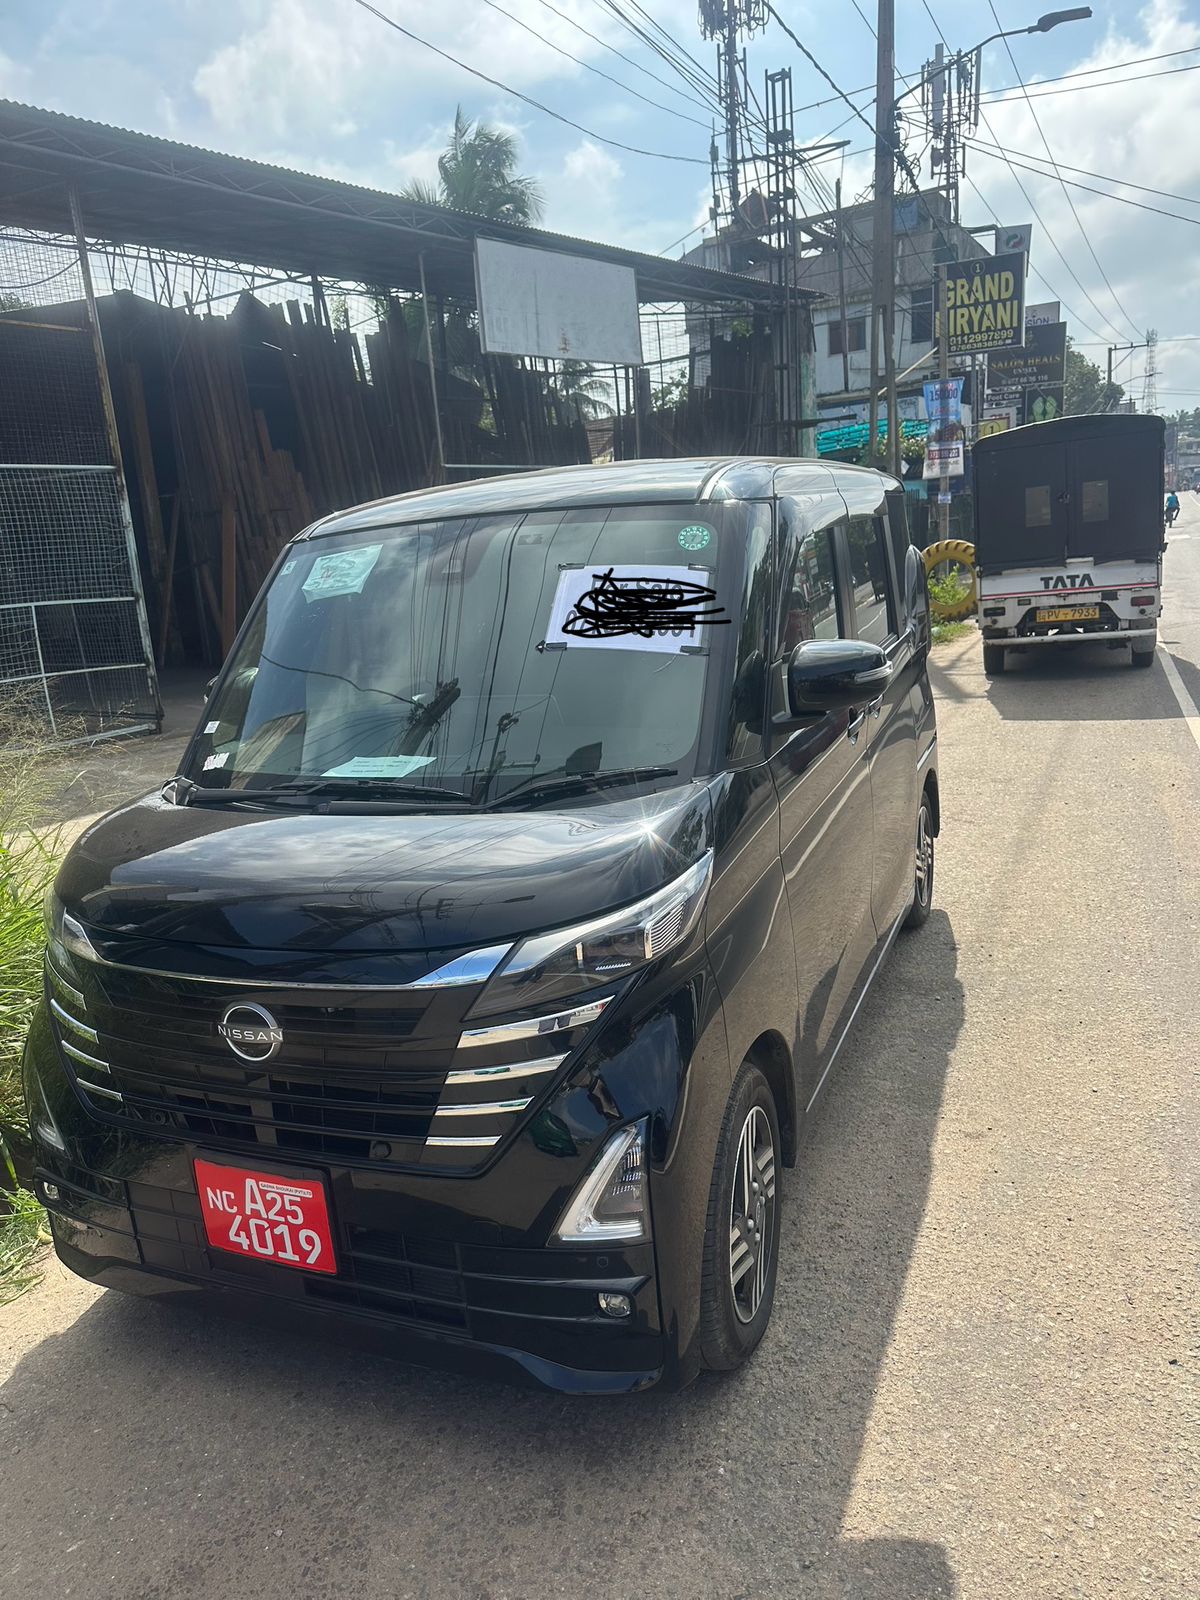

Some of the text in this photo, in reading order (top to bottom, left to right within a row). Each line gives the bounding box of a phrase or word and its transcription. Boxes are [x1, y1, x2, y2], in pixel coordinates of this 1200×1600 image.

[946, 271, 1014, 308] GRAND
[950, 329, 1014, 345] 0112997899
[991, 360, 1024, 369] SALON
[1040, 573, 1094, 590] TATA
[217, 1024, 283, 1041] NISSAN
[206, 1178, 304, 1225] NC A25
[229, 1215, 322, 1265] 4019
